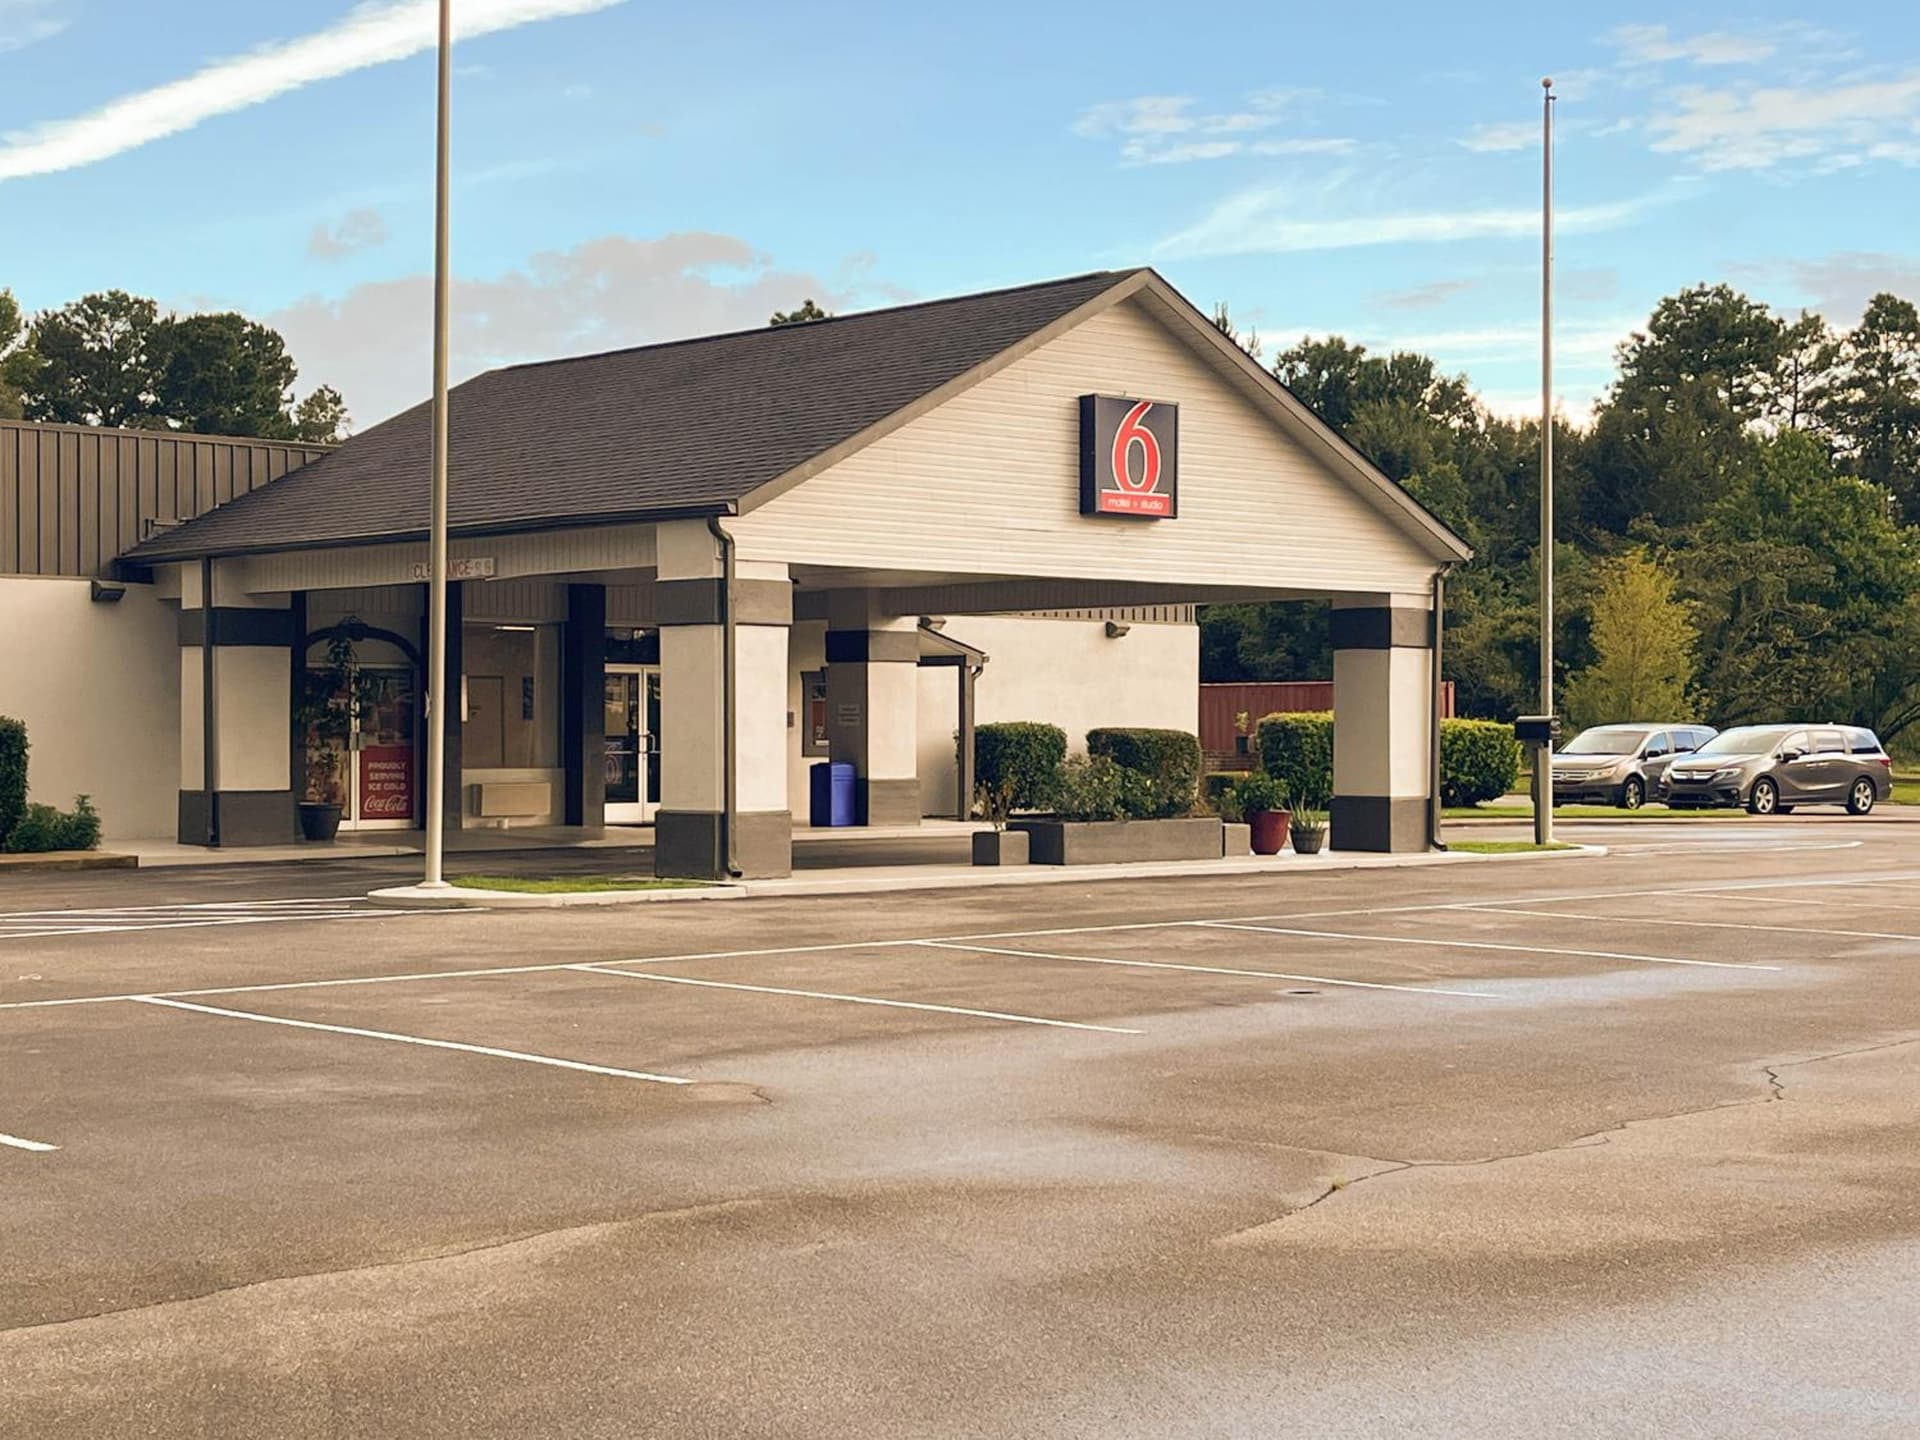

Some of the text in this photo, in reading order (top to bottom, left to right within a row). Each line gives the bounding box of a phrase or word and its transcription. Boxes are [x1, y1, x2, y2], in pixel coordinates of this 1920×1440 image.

[1111, 400, 1161, 494] 6
[368, 762, 405, 770] PROUDLY
[369, 772, 405, 781] SERVING
[368, 783, 406, 791] ICE COLD
